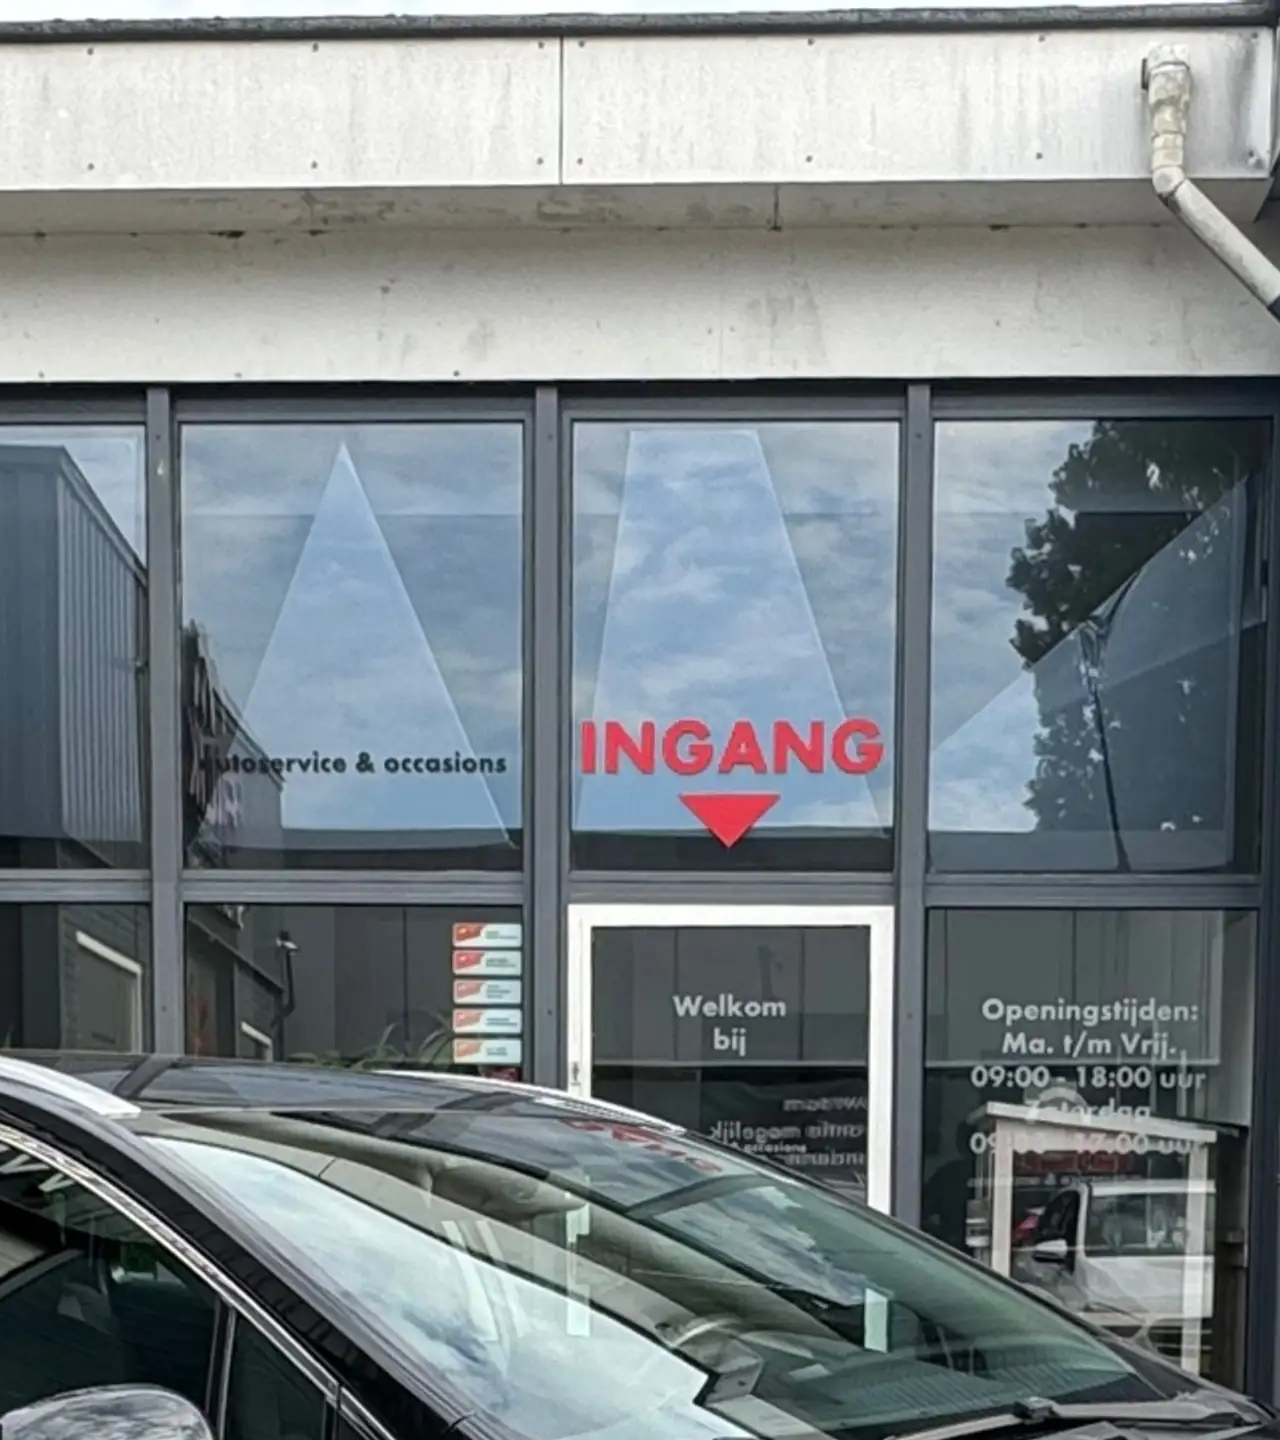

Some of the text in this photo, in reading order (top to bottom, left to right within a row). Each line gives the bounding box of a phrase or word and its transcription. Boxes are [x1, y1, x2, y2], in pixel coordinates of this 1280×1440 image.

[355, 751, 376, 773] &
[383, 750, 508, 774] occasions
[580, 719, 885, 775] INGANG
[672, 993, 787, 1018] Welkom
[981, 997, 1200, 1028] Openingstijden:
[713, 1027, 747, 1057] bij
[1002, 1031, 1177, 1061] Ma. t/m Vrij.
[970, 1065, 1050, 1089] 09:00
[1075, 1065, 1153, 1089] 18:00
[1160, 1072, 1207, 1090] uur
